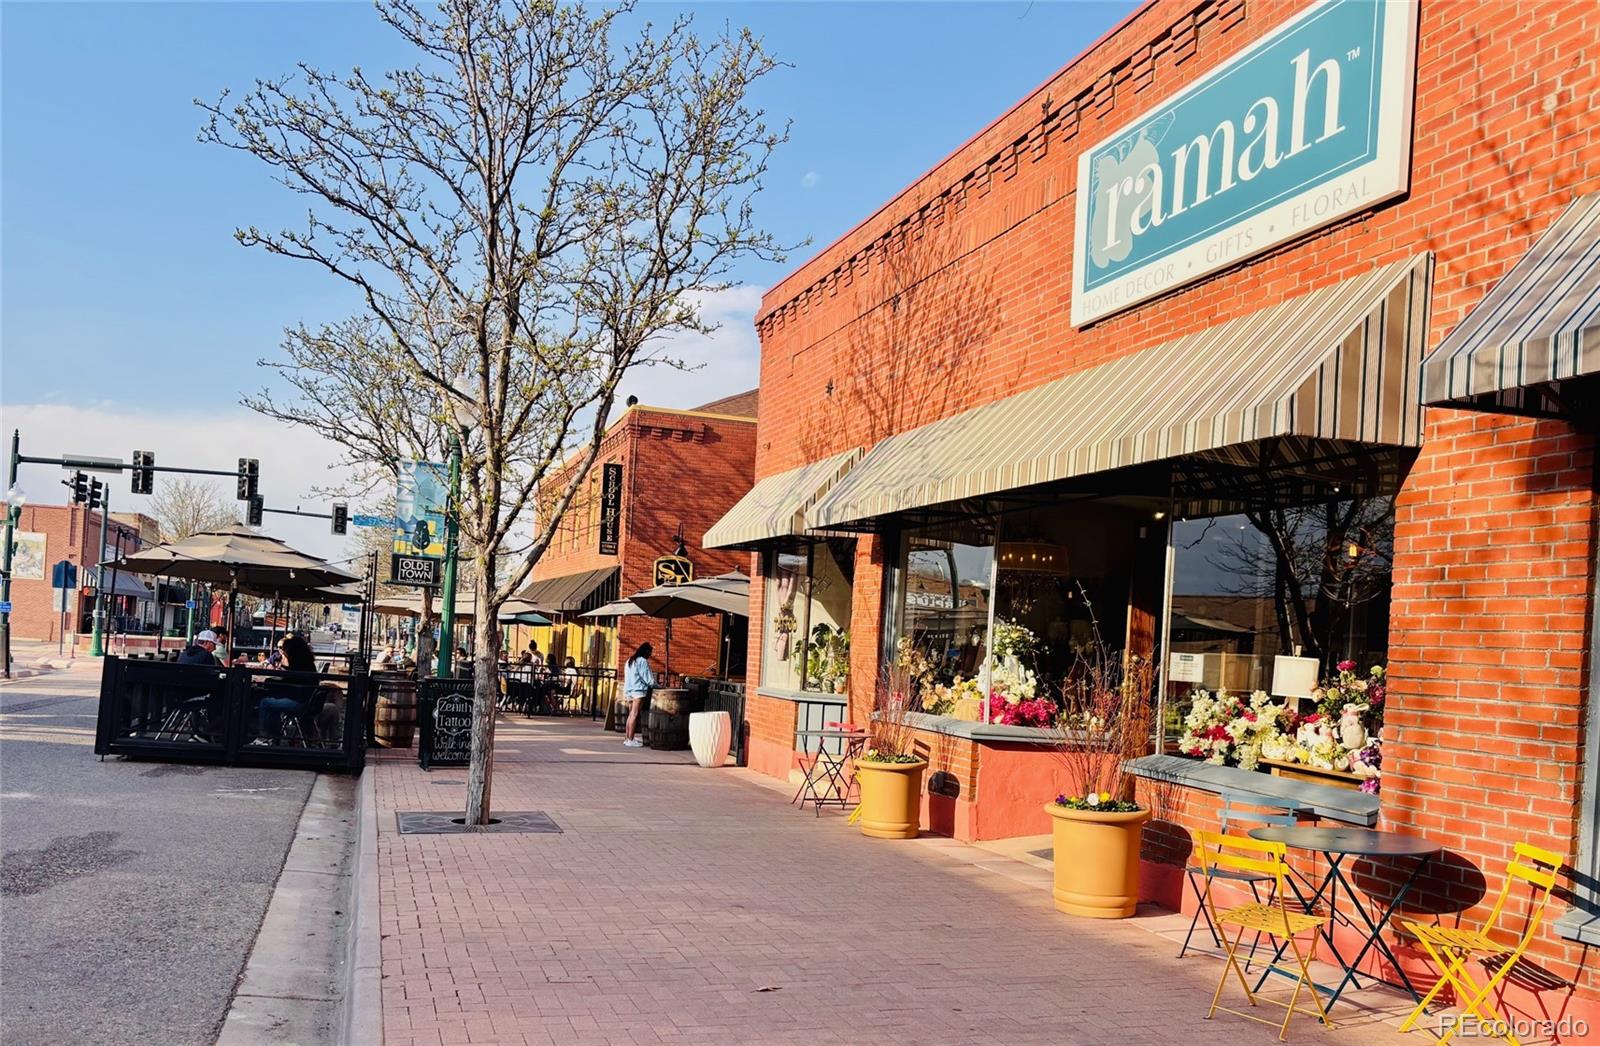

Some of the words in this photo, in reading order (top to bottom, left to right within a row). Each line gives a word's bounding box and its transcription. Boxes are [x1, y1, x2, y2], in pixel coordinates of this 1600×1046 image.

[1101, 47, 1346, 251] ramah
[1081, 289, 1121, 317] HOME
[1125, 262, 1175, 299] DECOR
[1205, 227, 1254, 265] GIFTS
[1290, 175, 1372, 227] FLORAL
[608, 467, 617, 506] SCHOOL
[606, 507, 615, 542] HOUSE
[400, 569, 432, 580] TOWN
[402, 560, 430, 571] OLDE
[439, 700, 472, 712] Zenith
[439, 714, 472, 728] Tattoo
